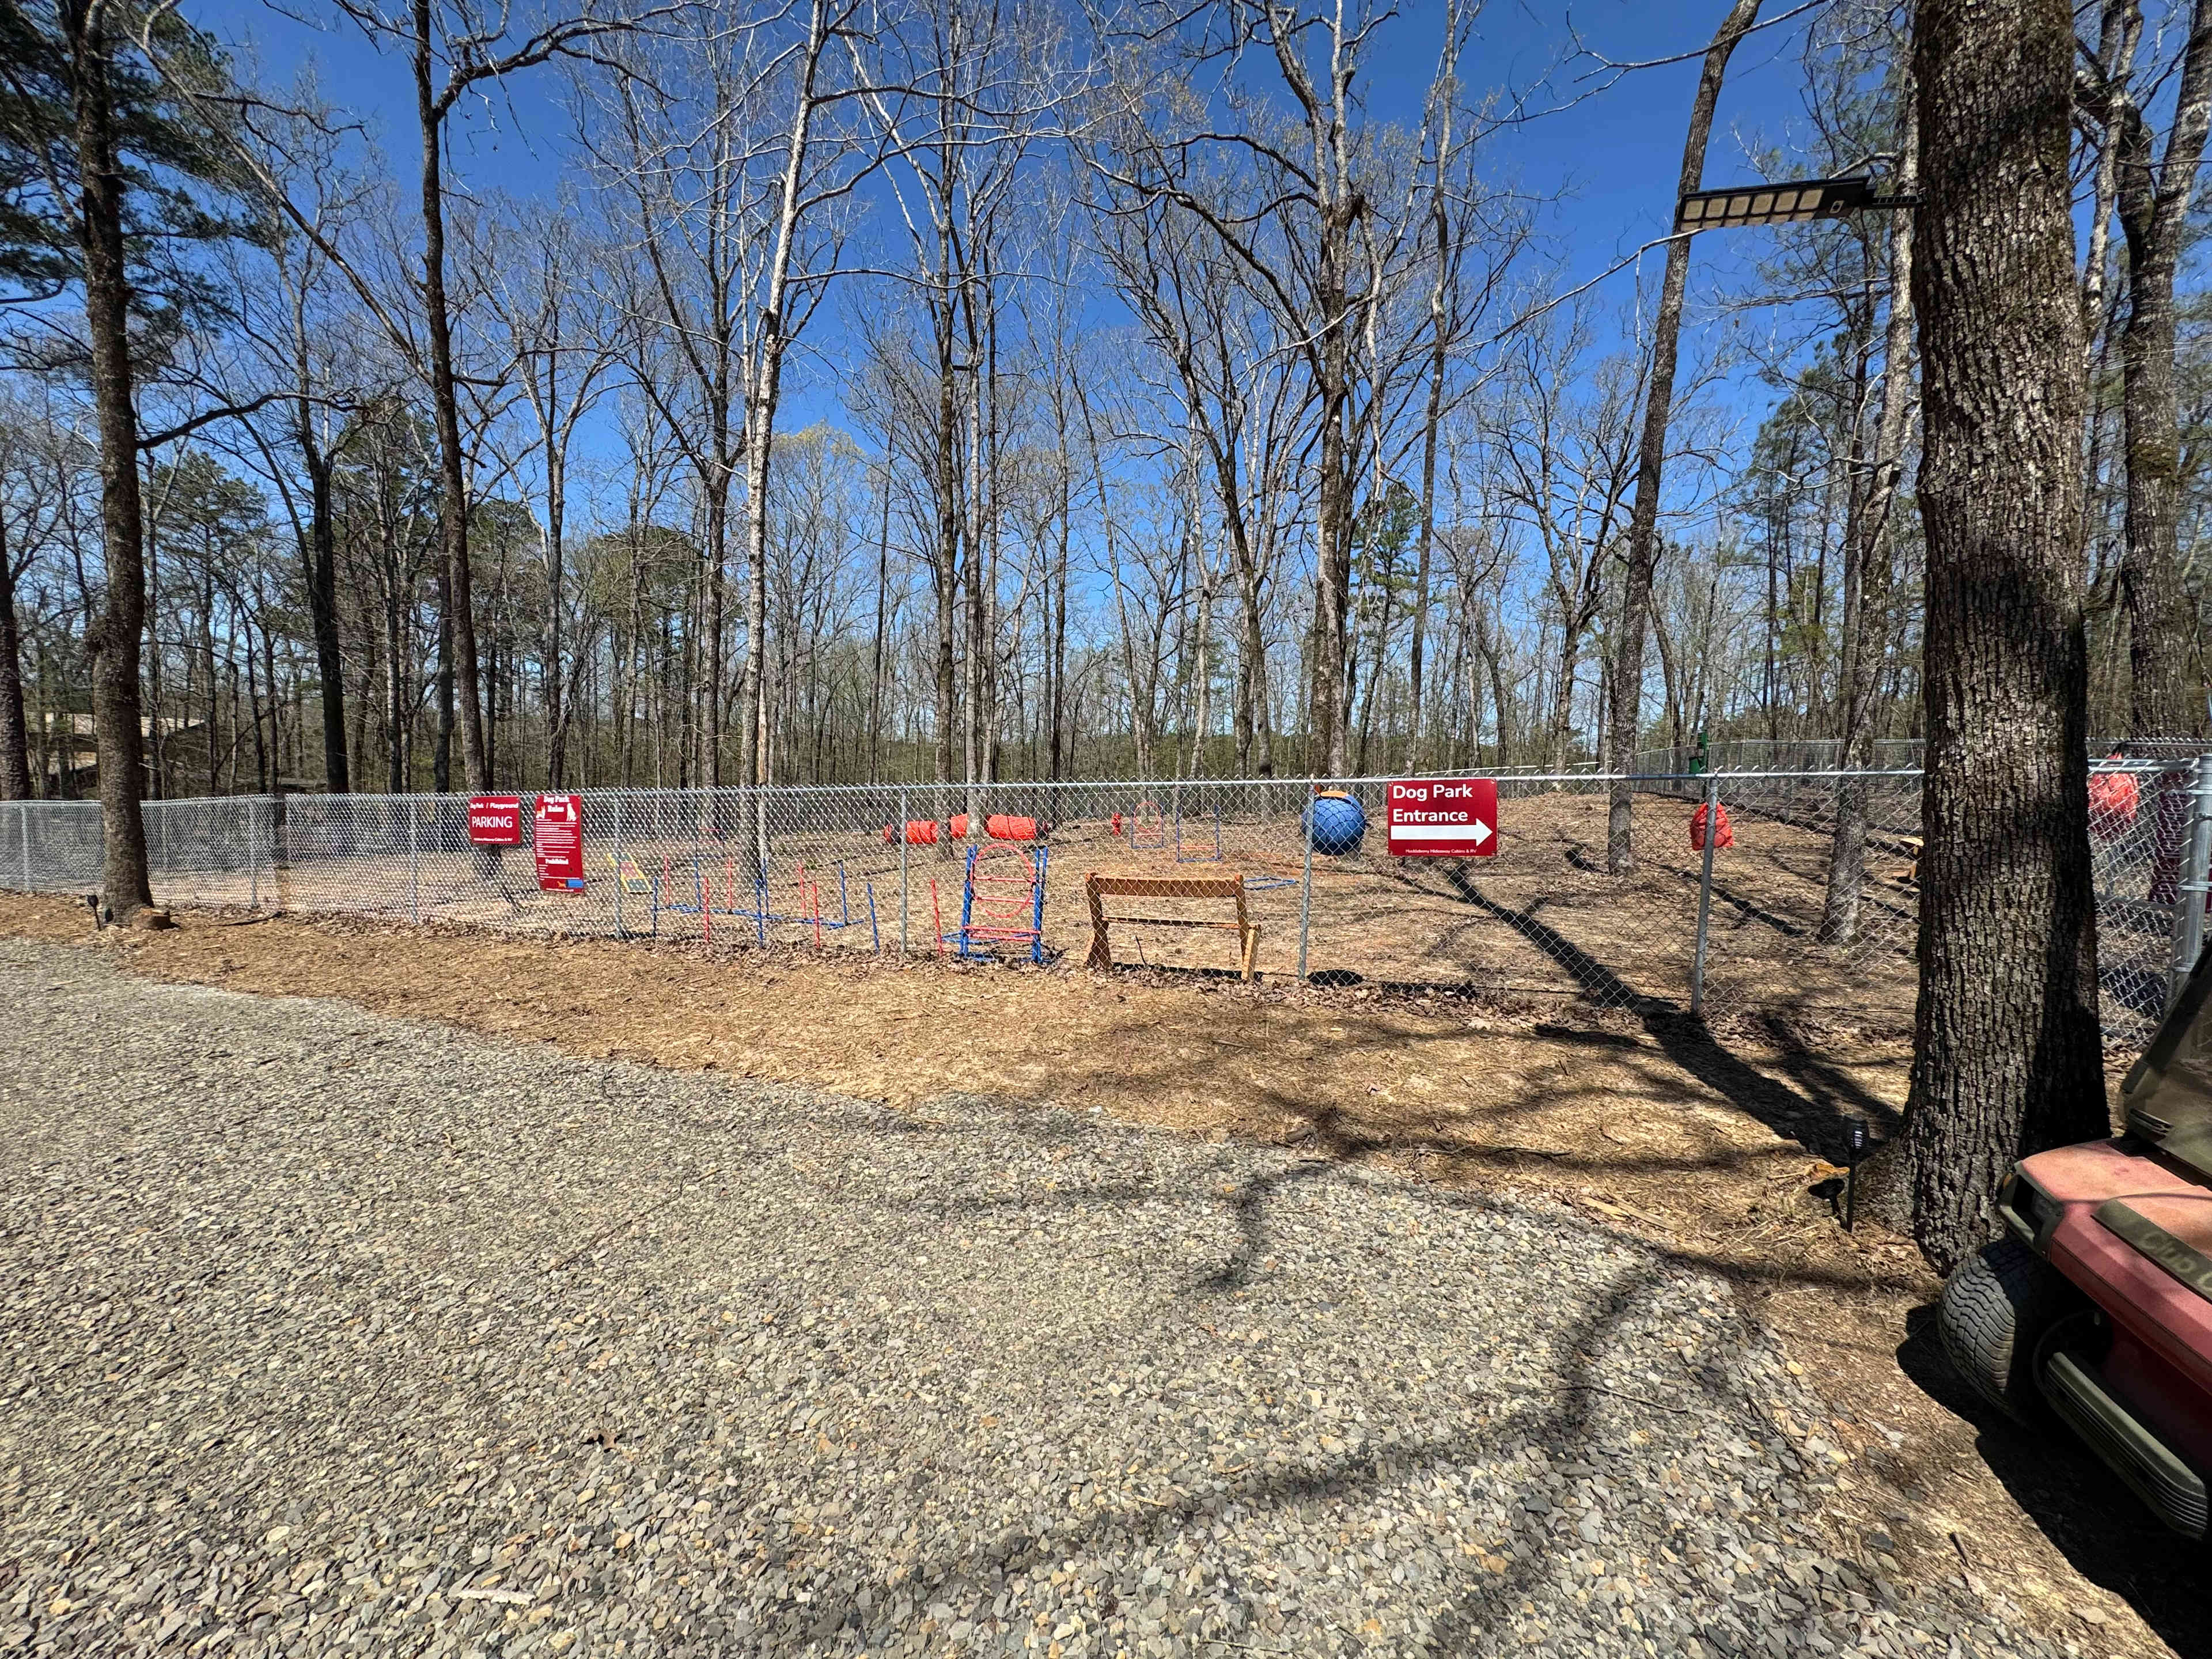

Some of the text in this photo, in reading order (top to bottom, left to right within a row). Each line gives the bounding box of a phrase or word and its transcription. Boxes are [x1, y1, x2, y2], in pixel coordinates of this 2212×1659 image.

[1393, 783, 1473, 801] Dog Park
[472, 816, 513, 828] PARKING
[1393, 808, 1468, 822] Entrance
